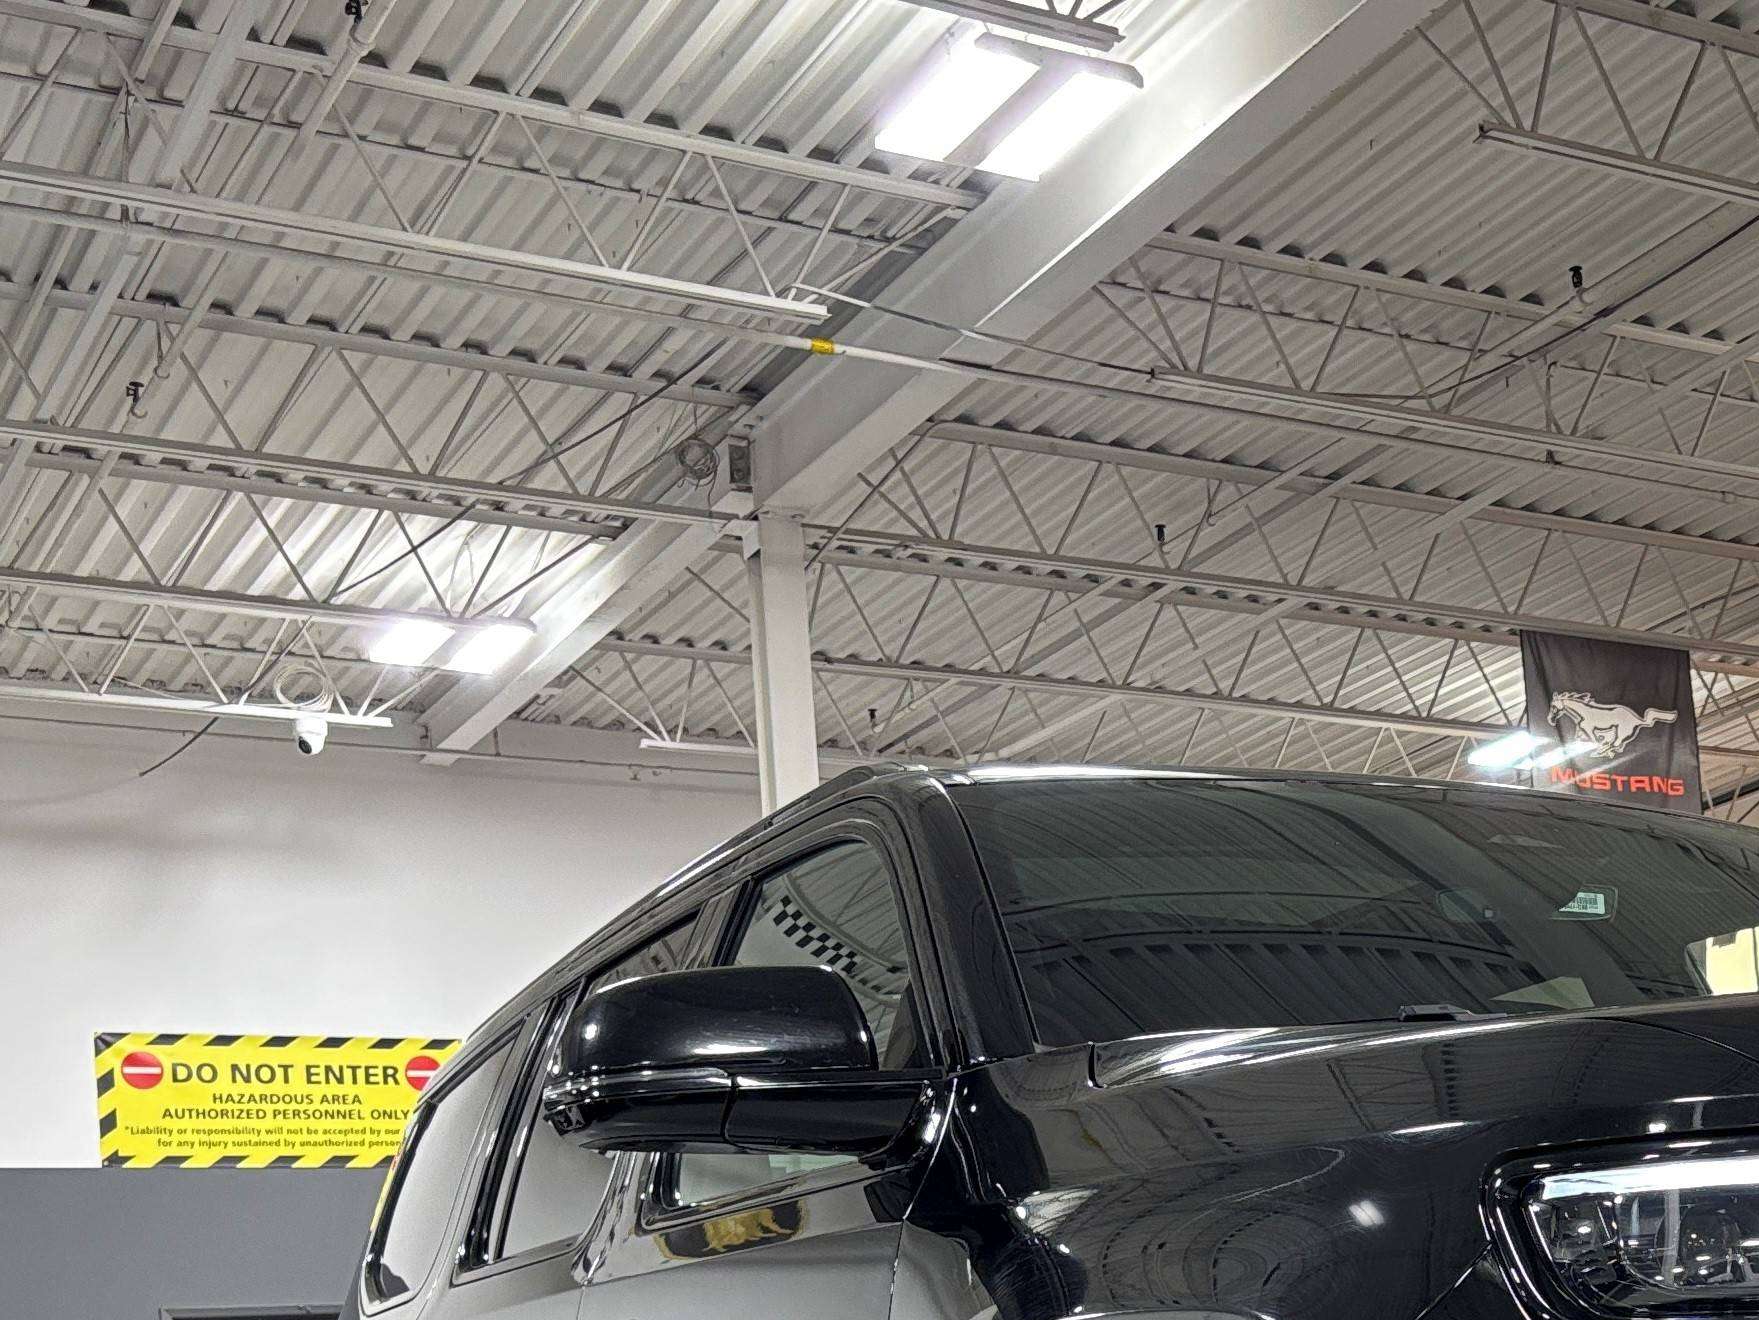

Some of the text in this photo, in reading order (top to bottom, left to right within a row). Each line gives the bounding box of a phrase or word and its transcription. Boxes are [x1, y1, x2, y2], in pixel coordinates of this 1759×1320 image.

[1551, 767, 1685, 796] MUSTANG
[171, 1062, 400, 1086] DO NOT ENTER
[212, 1093, 362, 1105] HAZARDOUS AREA
[162, 1108, 410, 1120] AUTHORIZED PERSONNEL ONLY
[177, 1127, 188, 1135] or
[191, 1126, 262, 1136] responsibility
[265, 1126, 283, 1135] will
[286, 1126, 304, 1135] not
[306, 1126, 319, 1135] be
[322, 1126, 367, 1136] accepted
[369, 1126, 381, 1137] by
[157, 1138, 173, 1147] for
[176, 1139, 195, 1149] any
[198, 1138, 229, 1149] injury
[231, 1138, 281, 1147] sustained
[284, 1138, 296, 1149] by
[299, 1138, 366, 1148] unauthorized
